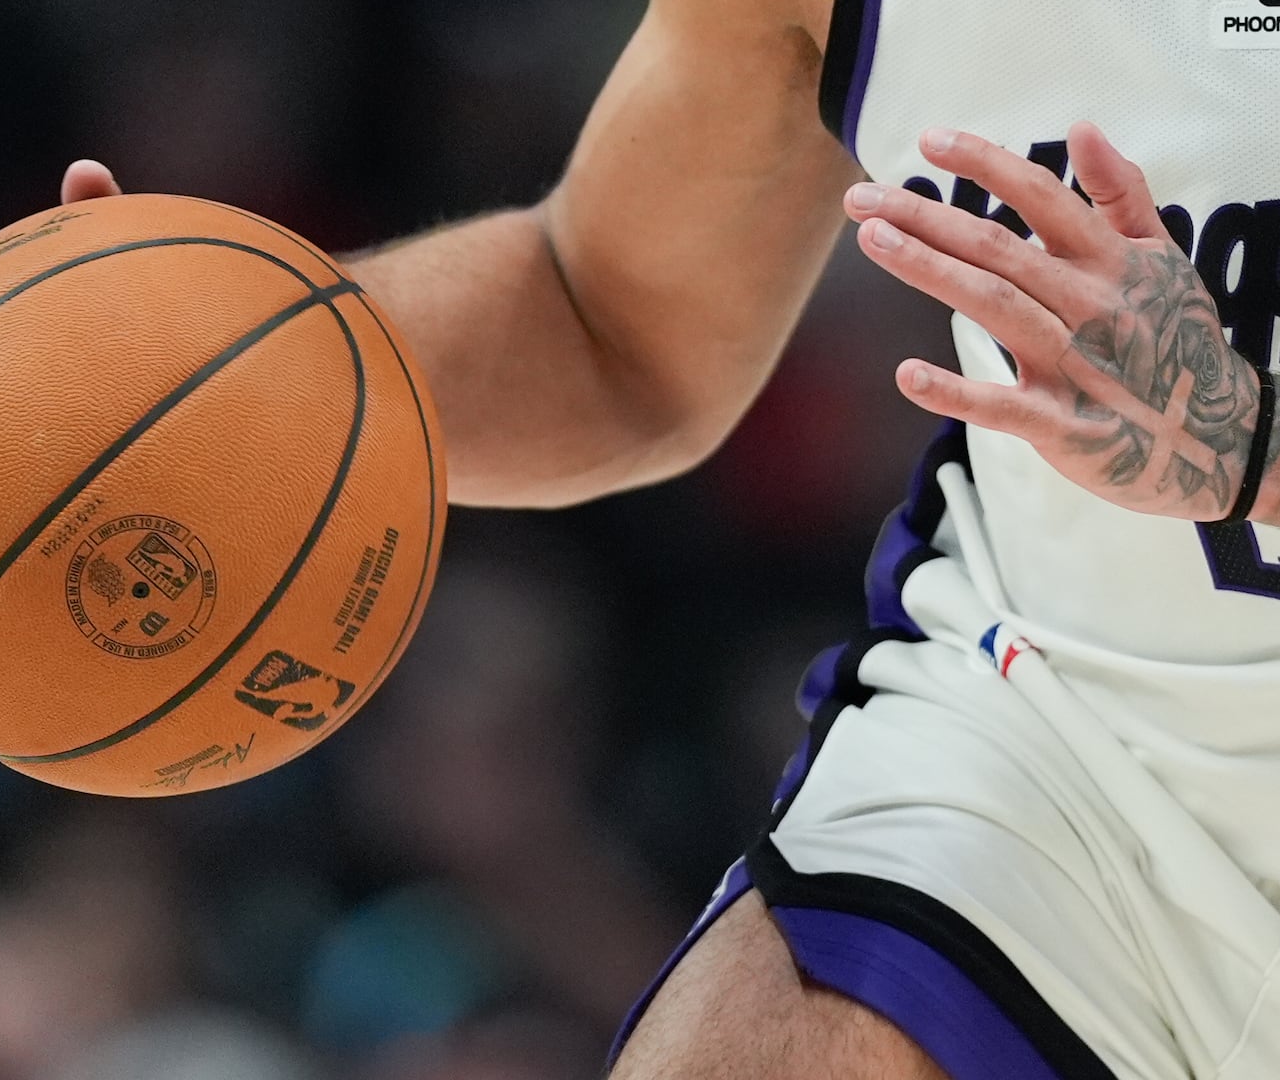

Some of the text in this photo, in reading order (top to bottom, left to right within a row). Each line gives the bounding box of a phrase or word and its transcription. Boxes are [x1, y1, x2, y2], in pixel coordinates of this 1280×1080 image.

[98, 518, 137, 539] INFLATE
[140, 518, 152, 528] TO
[68, 554, 87, 626] MADE IN CHINA
[333, 527, 399, 654] OFFICIAL GAME BALL
[102, 636, 186, 657] DESIGNED IN USA
